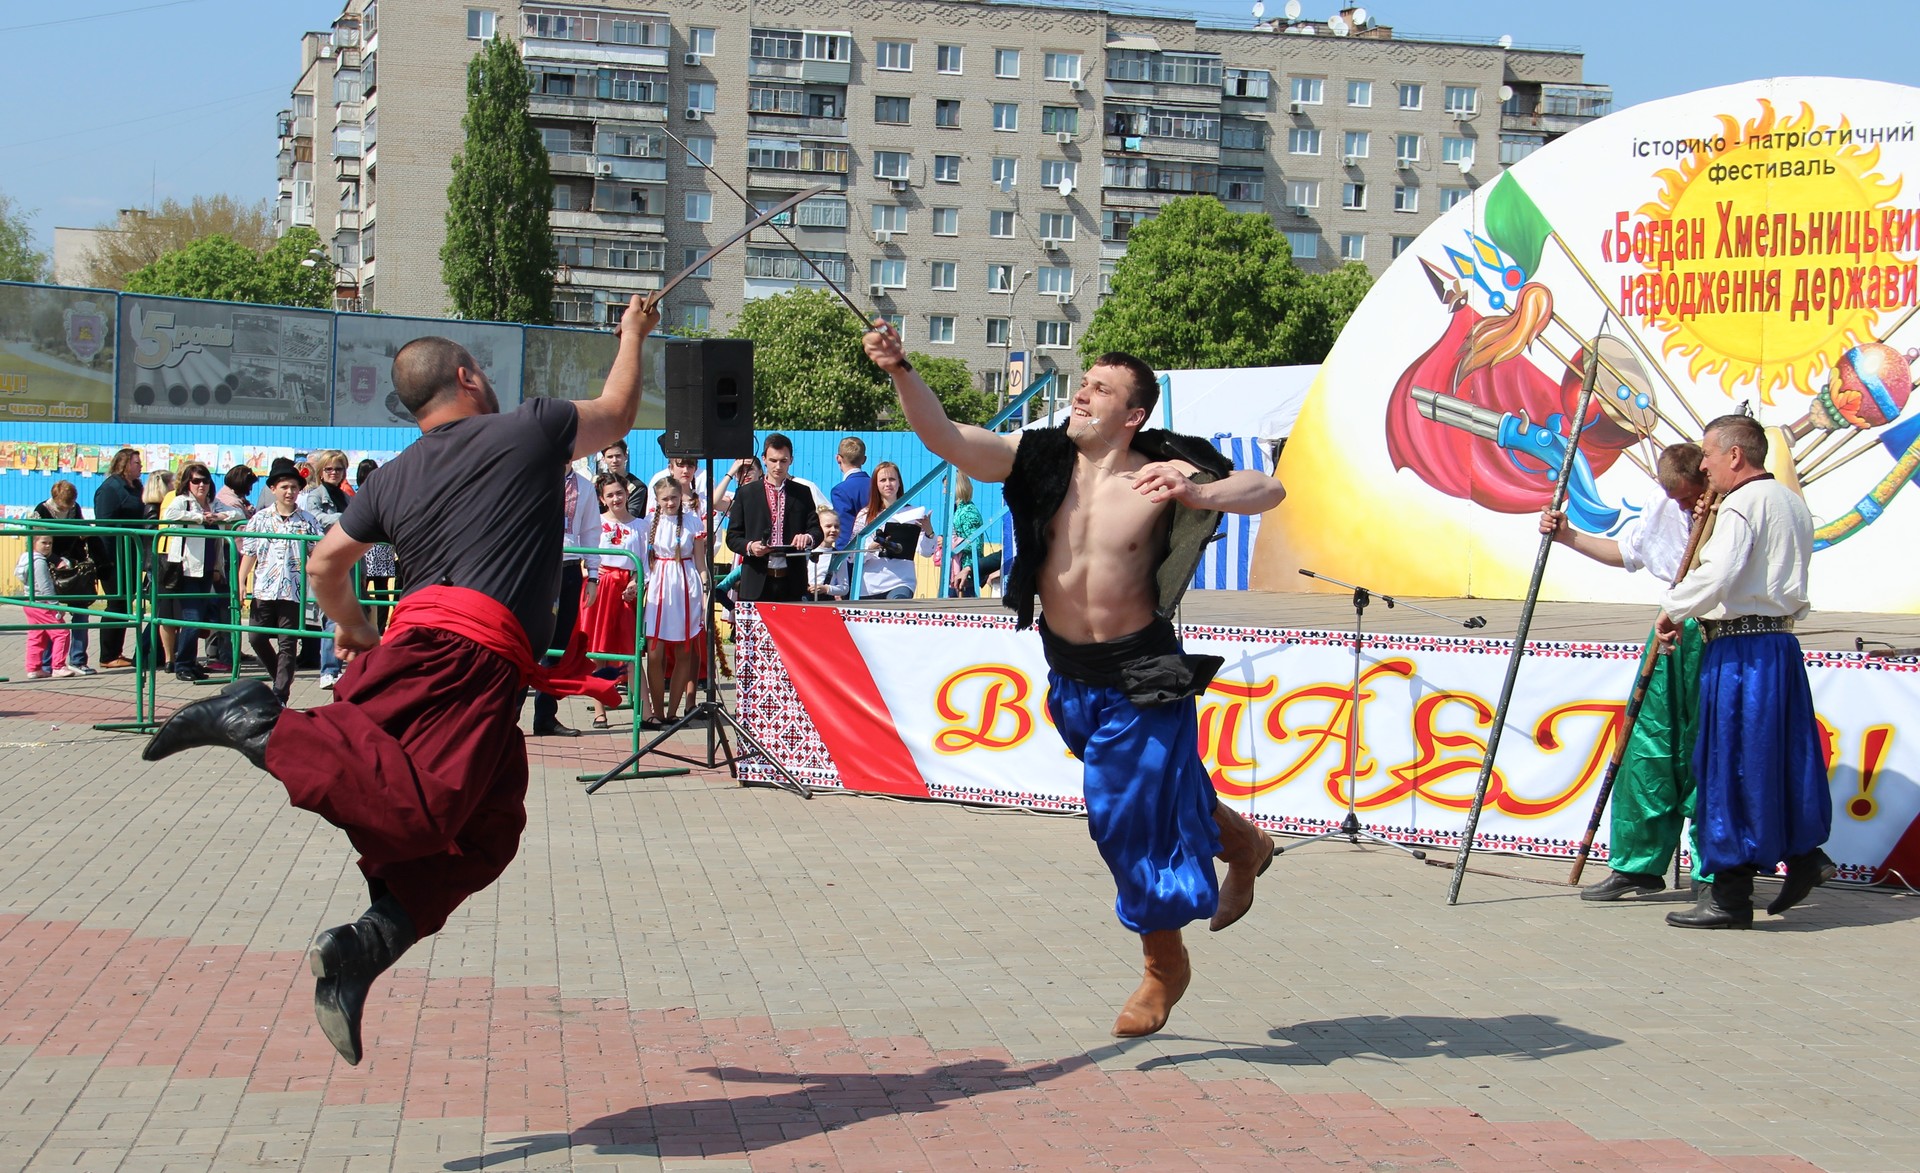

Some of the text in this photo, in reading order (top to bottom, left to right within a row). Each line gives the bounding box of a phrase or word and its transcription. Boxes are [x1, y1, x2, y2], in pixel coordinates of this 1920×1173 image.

[1633, 138, 1726, 160] історико
[1749, 121, 1914, 151] патріотичний
[1708, 159, 1836, 185] фестиваль
[1600, 198, 1920, 271] «Богдан Хмельницьки
[1620, 264, 1918, 327] народження держави
[134, 311, 175, 369] 5
[48, 402, 88, 418] місто!
